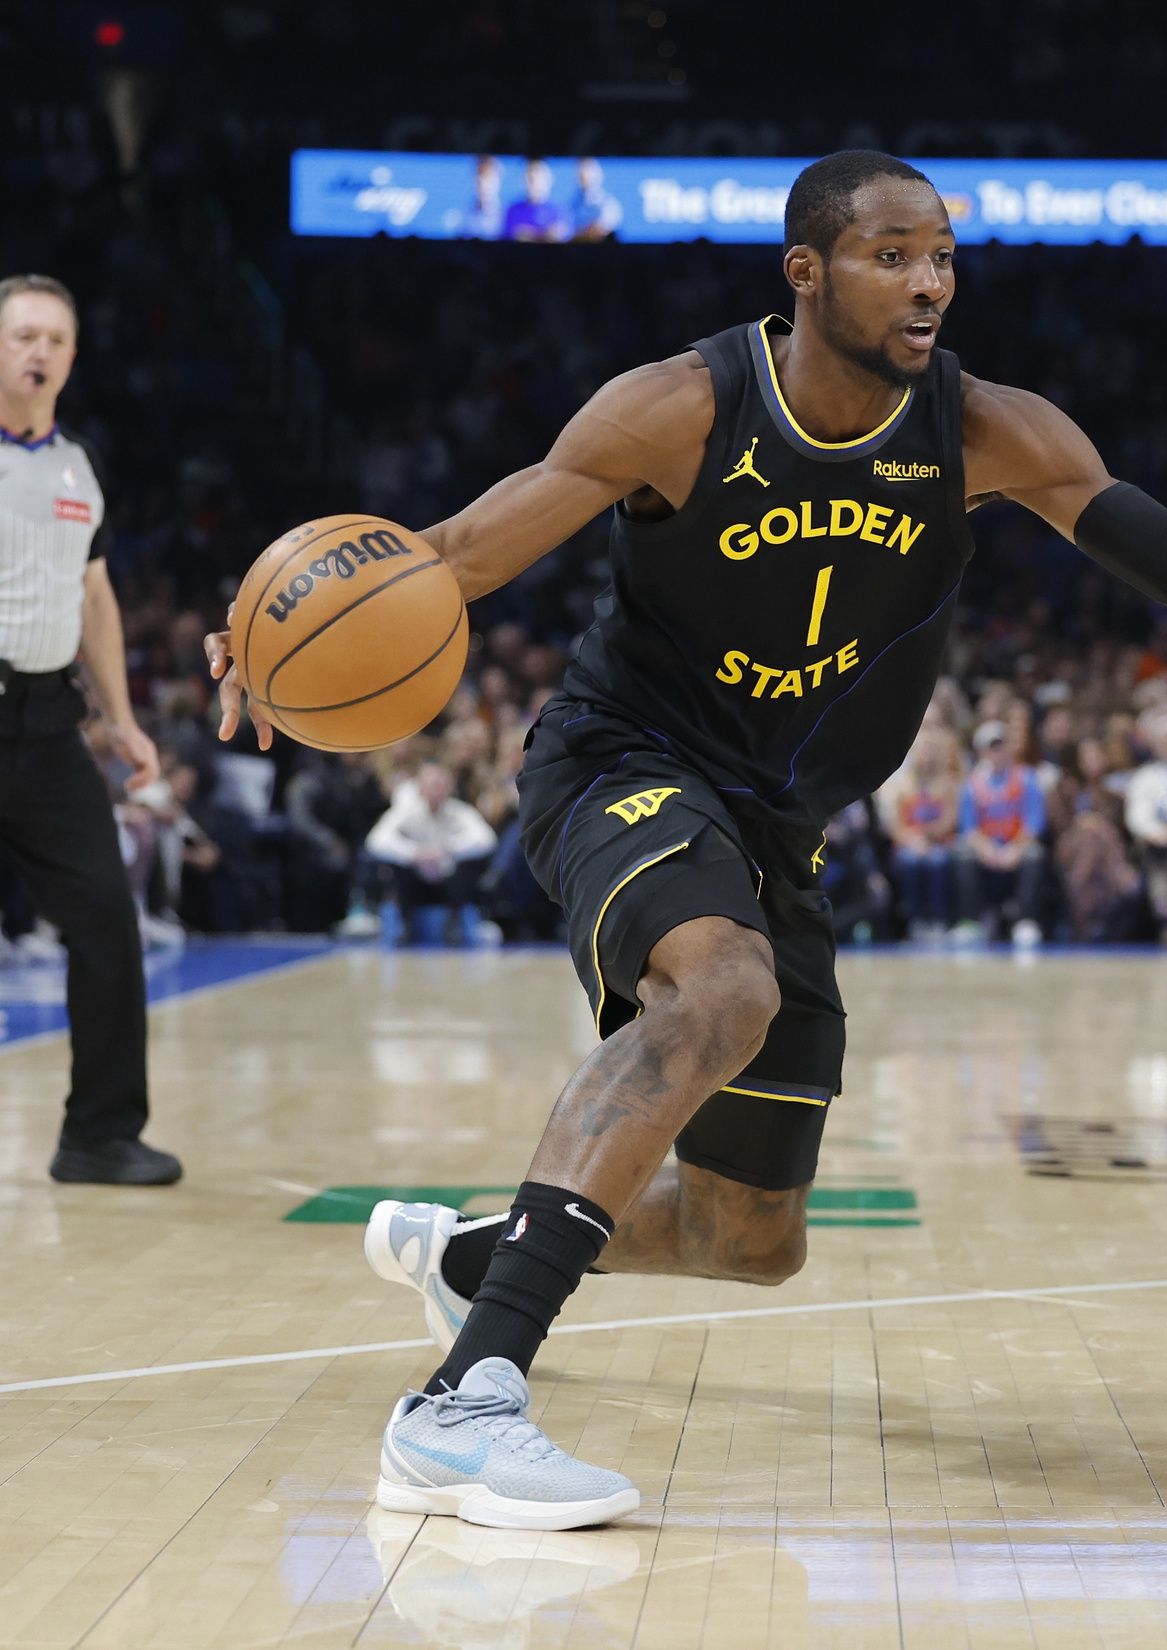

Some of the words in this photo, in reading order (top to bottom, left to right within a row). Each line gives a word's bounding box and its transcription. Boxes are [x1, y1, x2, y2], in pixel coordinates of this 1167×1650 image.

[640, 178, 708, 224] The
[977, 180, 1023, 226] To
[1026, 180, 1103, 226] Ever
[873, 459, 940, 479] Rakuten
[719, 499, 926, 561] GOLDEN
[265, 529, 413, 624] Wilson
[806, 565, 834, 647] 1
[715, 638, 860, 699] STATE
